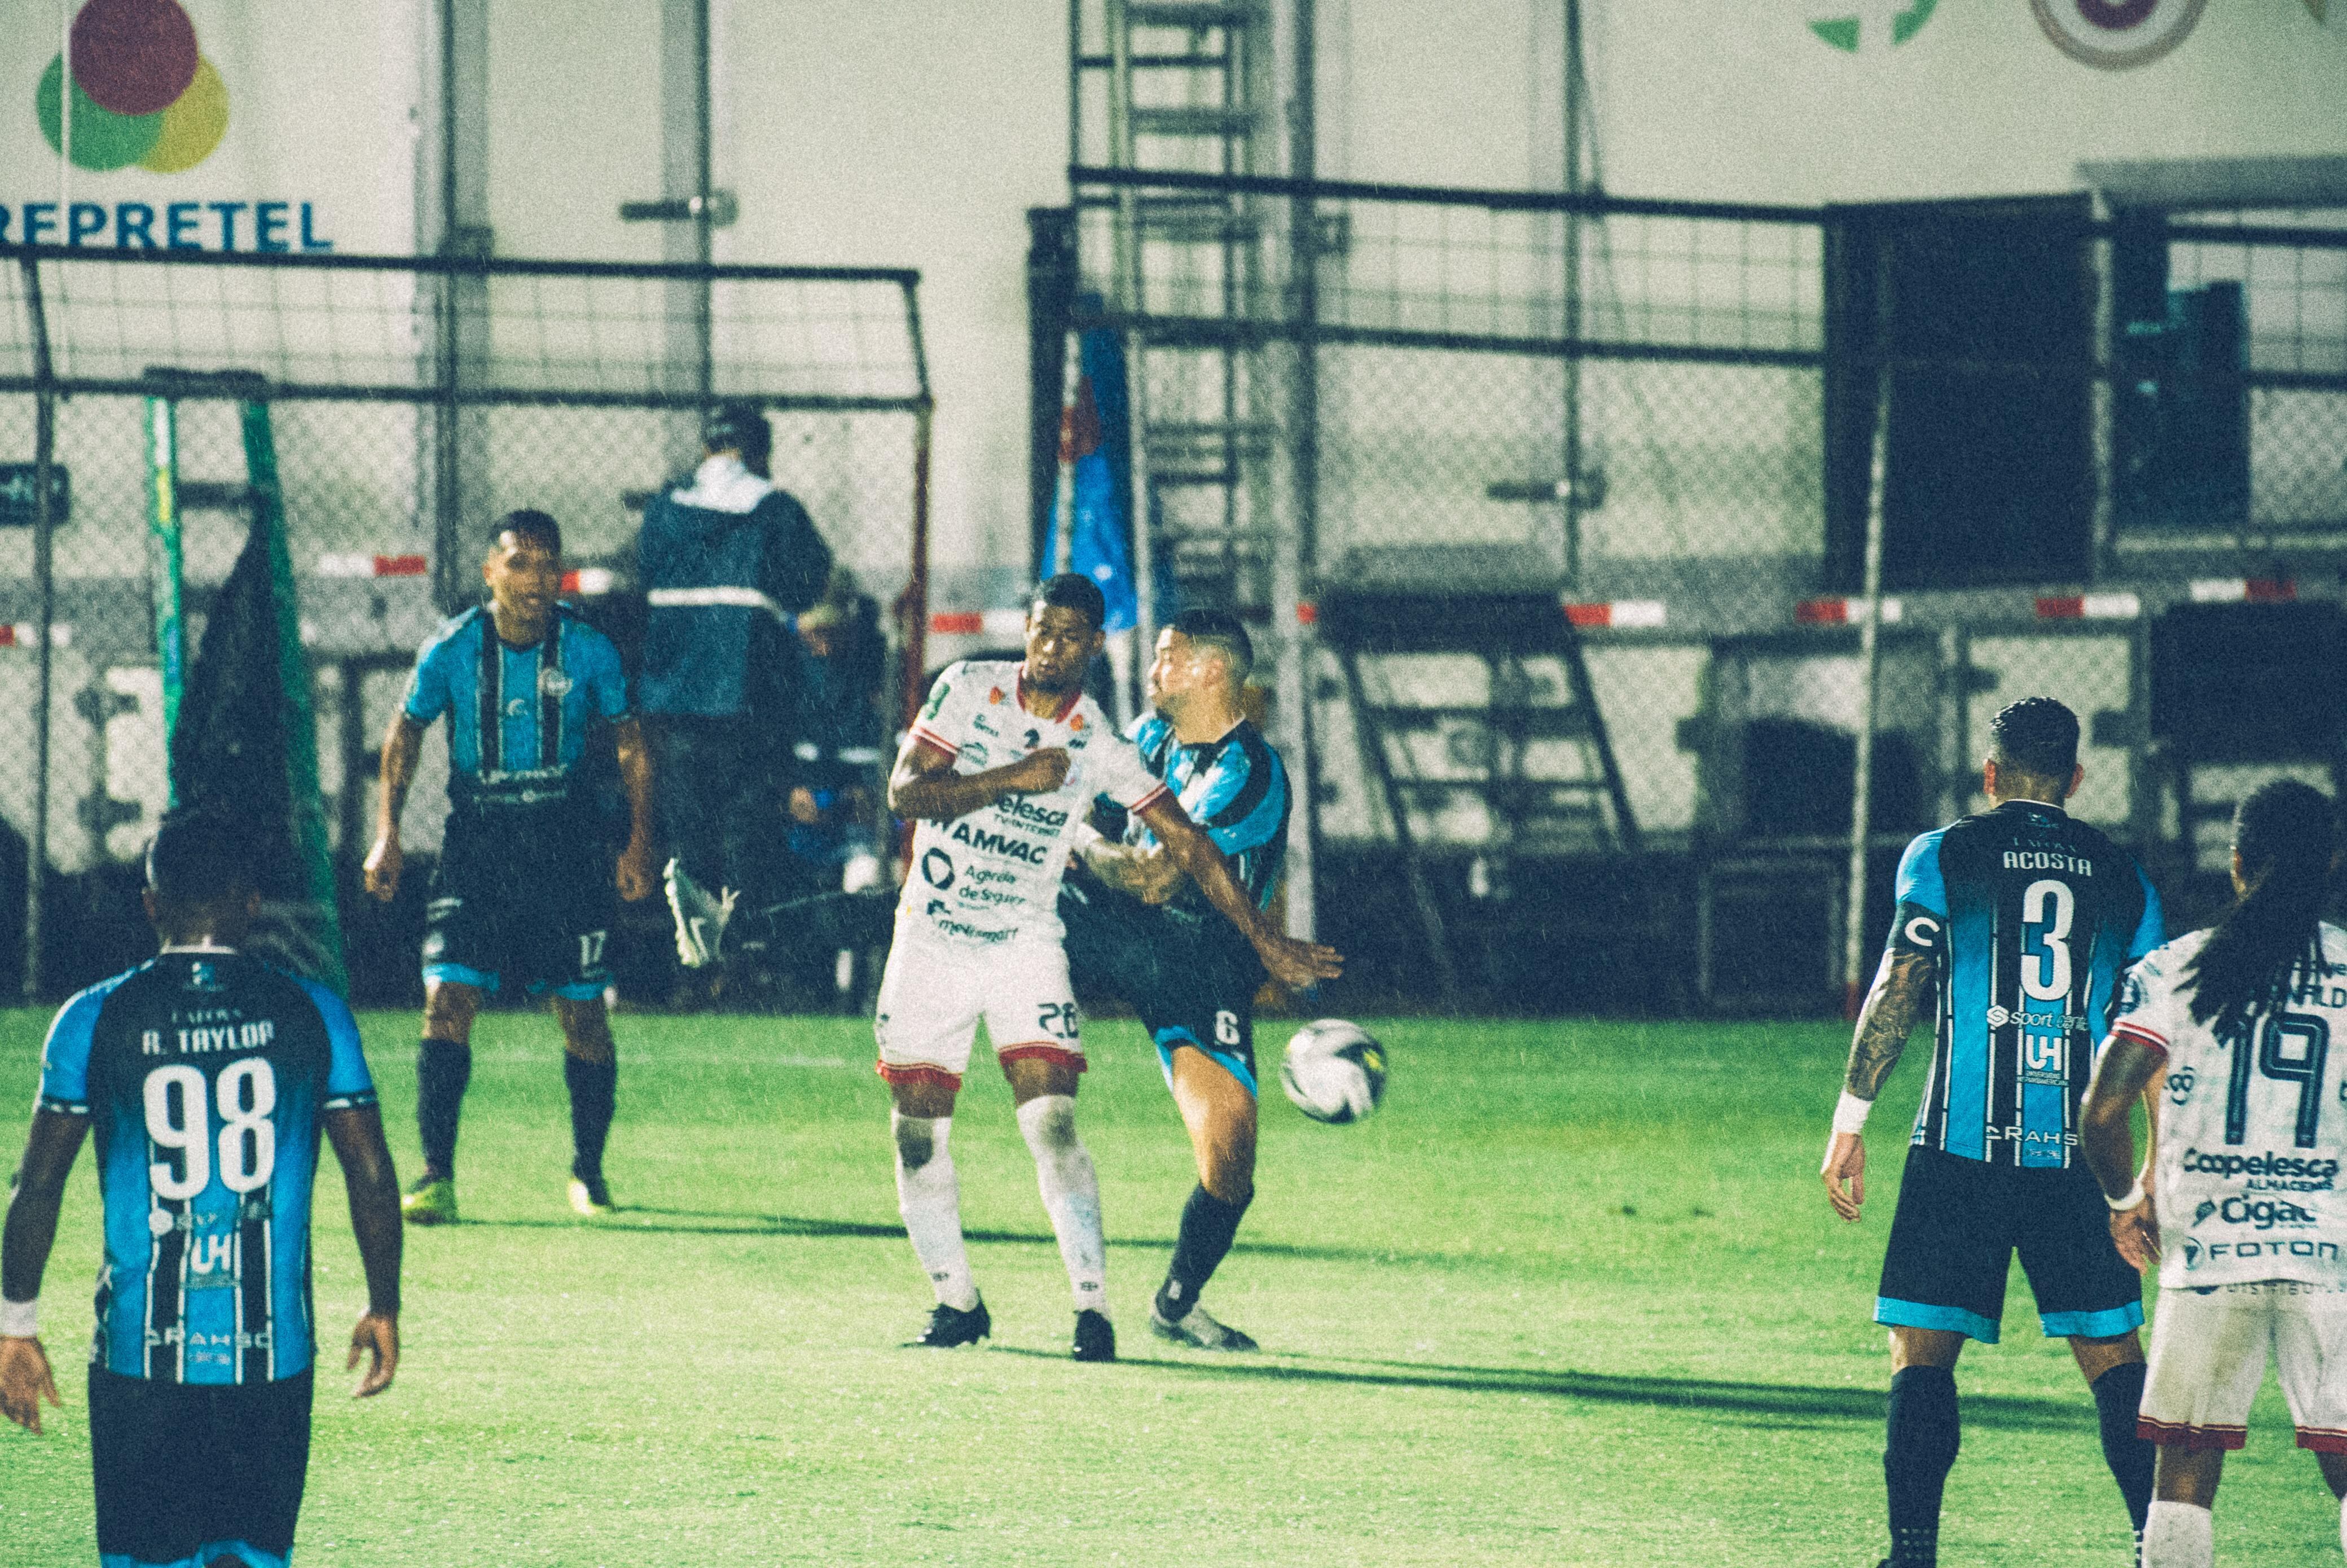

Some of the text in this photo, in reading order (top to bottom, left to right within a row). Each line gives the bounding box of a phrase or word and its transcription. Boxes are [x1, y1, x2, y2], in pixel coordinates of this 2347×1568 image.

[0, 201, 334, 253] EPRETEL
[2003, 851, 2092, 876] ACOSTA
[579, 930, 606, 966] 17
[1904, 917, 1940, 947] C
[2020, 879, 2074, 1001] 3
[178, 1020, 275, 1053] TAYLOR
[1214, 1009, 1241, 1045] 6
[2009, 1011, 2053, 1027] sport
[2214, 1011, 2331, 1148] 19
[143, 1056, 277, 1201] 98
[2209, 1241, 2339, 1261] FOTON
